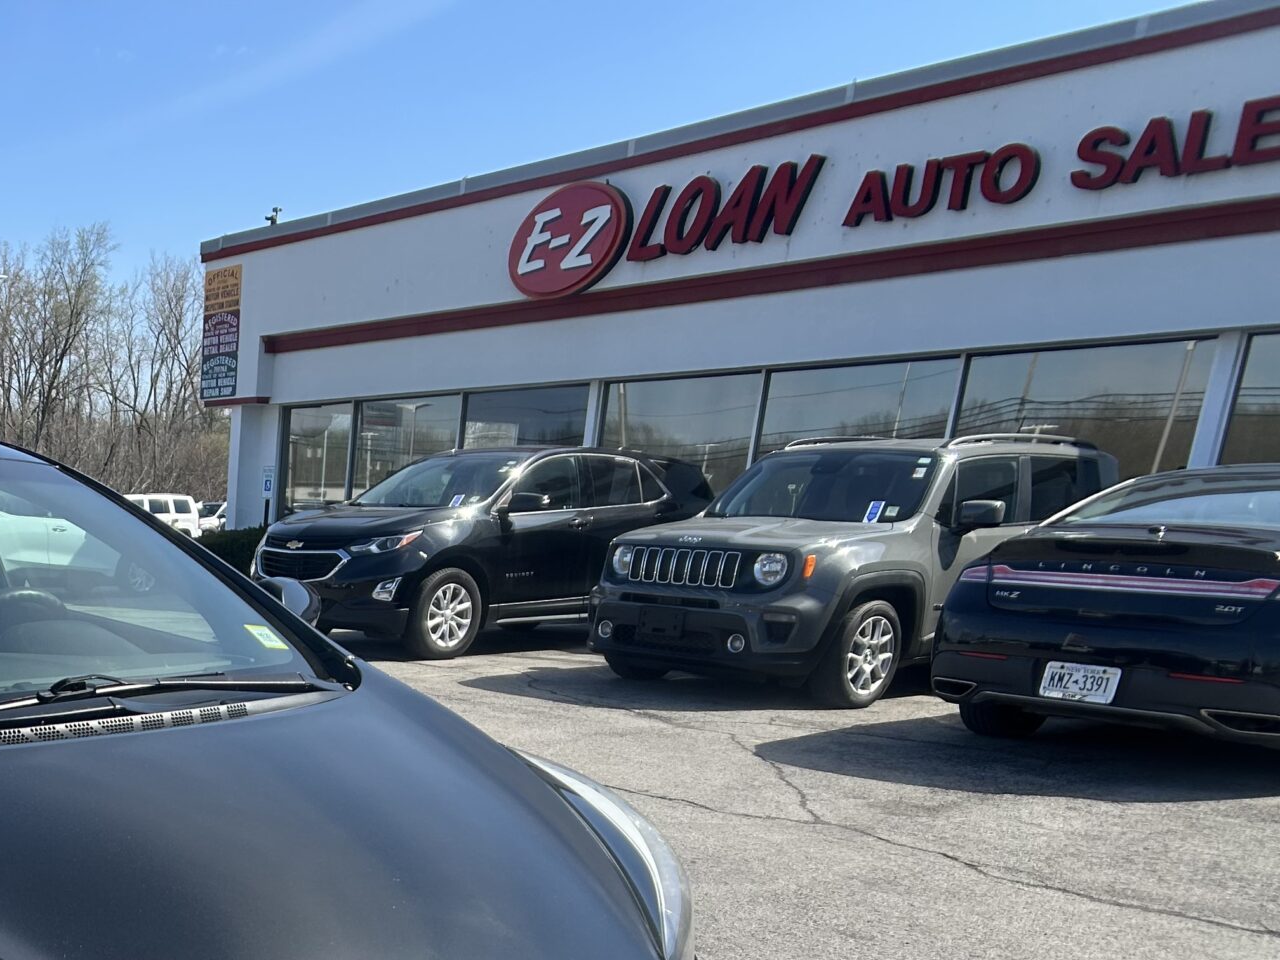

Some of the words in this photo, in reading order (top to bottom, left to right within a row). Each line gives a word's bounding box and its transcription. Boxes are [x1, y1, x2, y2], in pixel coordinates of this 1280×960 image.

[517, 204, 612, 275] E-Z
[626, 153, 827, 263] LOAN
[842, 143, 1041, 227] AUTO
[208, 269, 239, 286] OFFICIAL
[205, 312, 238, 331] REGISTERED
[203, 355, 236, 372] REGISTERED
[1038, 562, 1206, 578] LINCOLN
